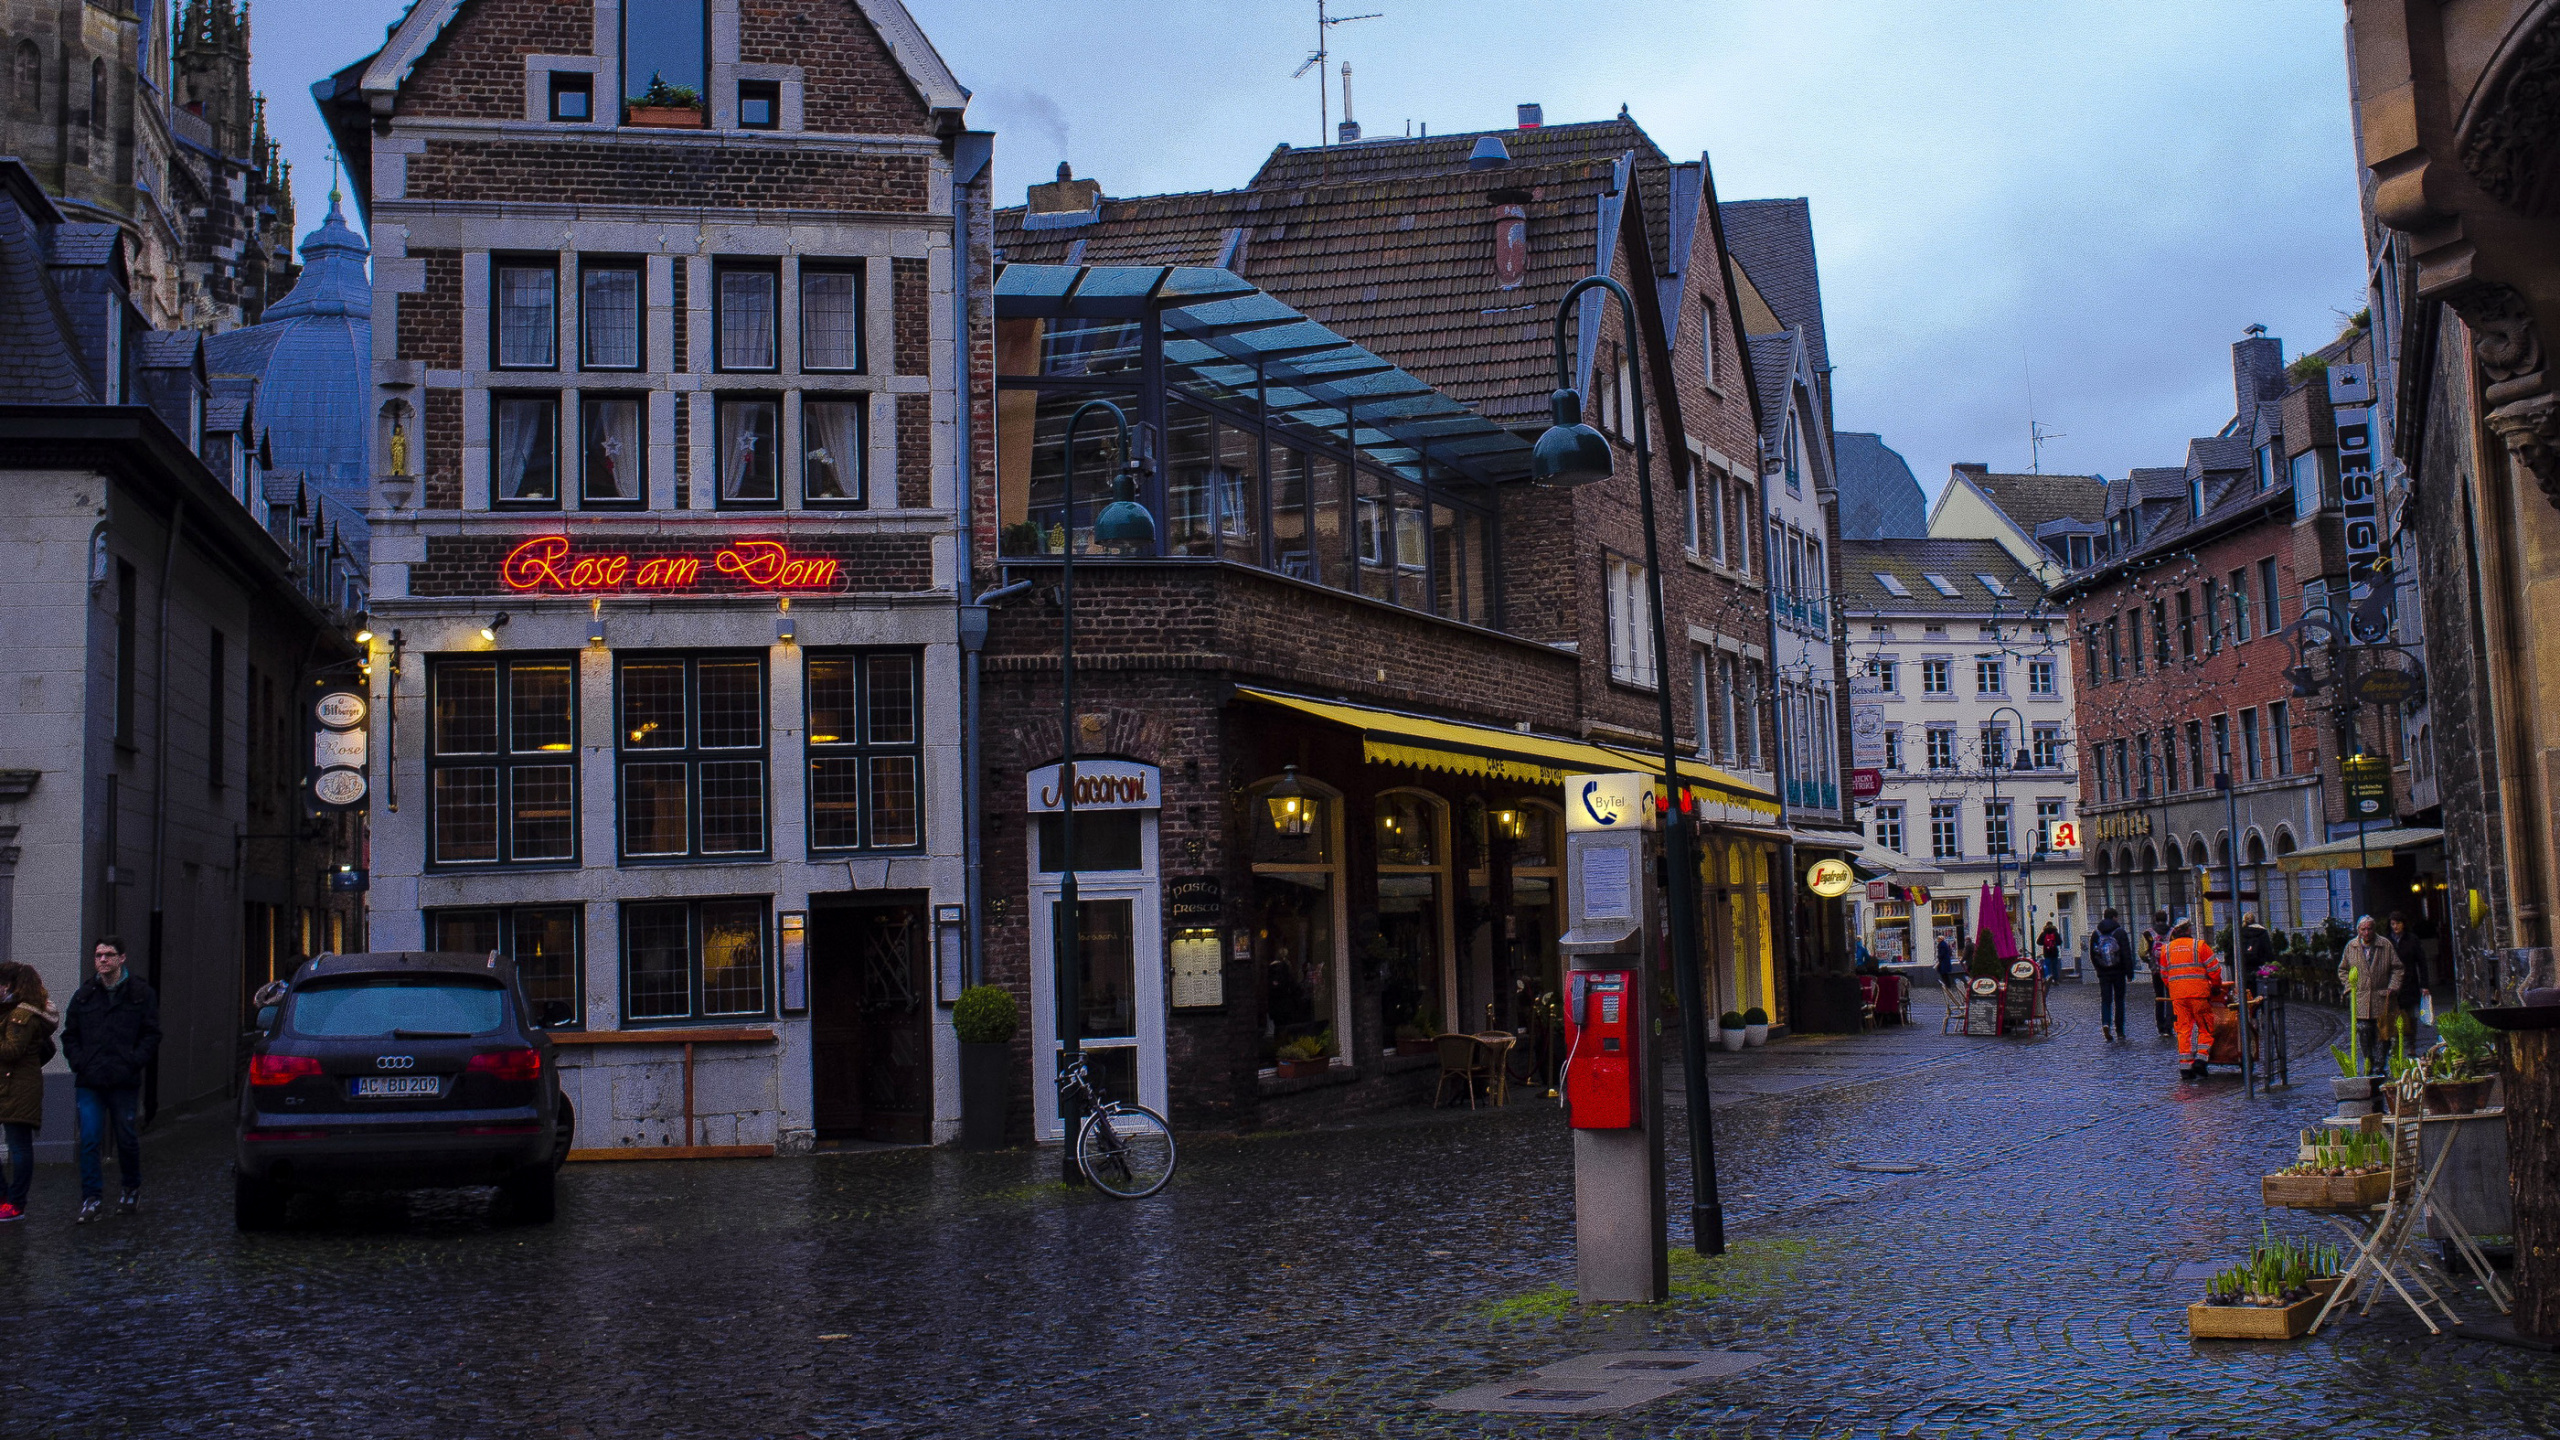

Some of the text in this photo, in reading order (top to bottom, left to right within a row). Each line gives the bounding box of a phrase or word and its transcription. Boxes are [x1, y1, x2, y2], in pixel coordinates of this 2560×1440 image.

[2337, 423, 2379, 583] DESIGN
[504, 536, 837, 589] Rose am Dom
[319, 741, 364, 755] Rose
[1042, 764, 1148, 808] Macaroni
[1853, 782, 1875, 790] TRIKE
[1596, 796, 1625, 811] ByTel
[2096, 810, 2151, 840] Apotheke
[1173, 882, 1218, 899] pasta
[360, 1077, 437, 1092] AC BD 209
